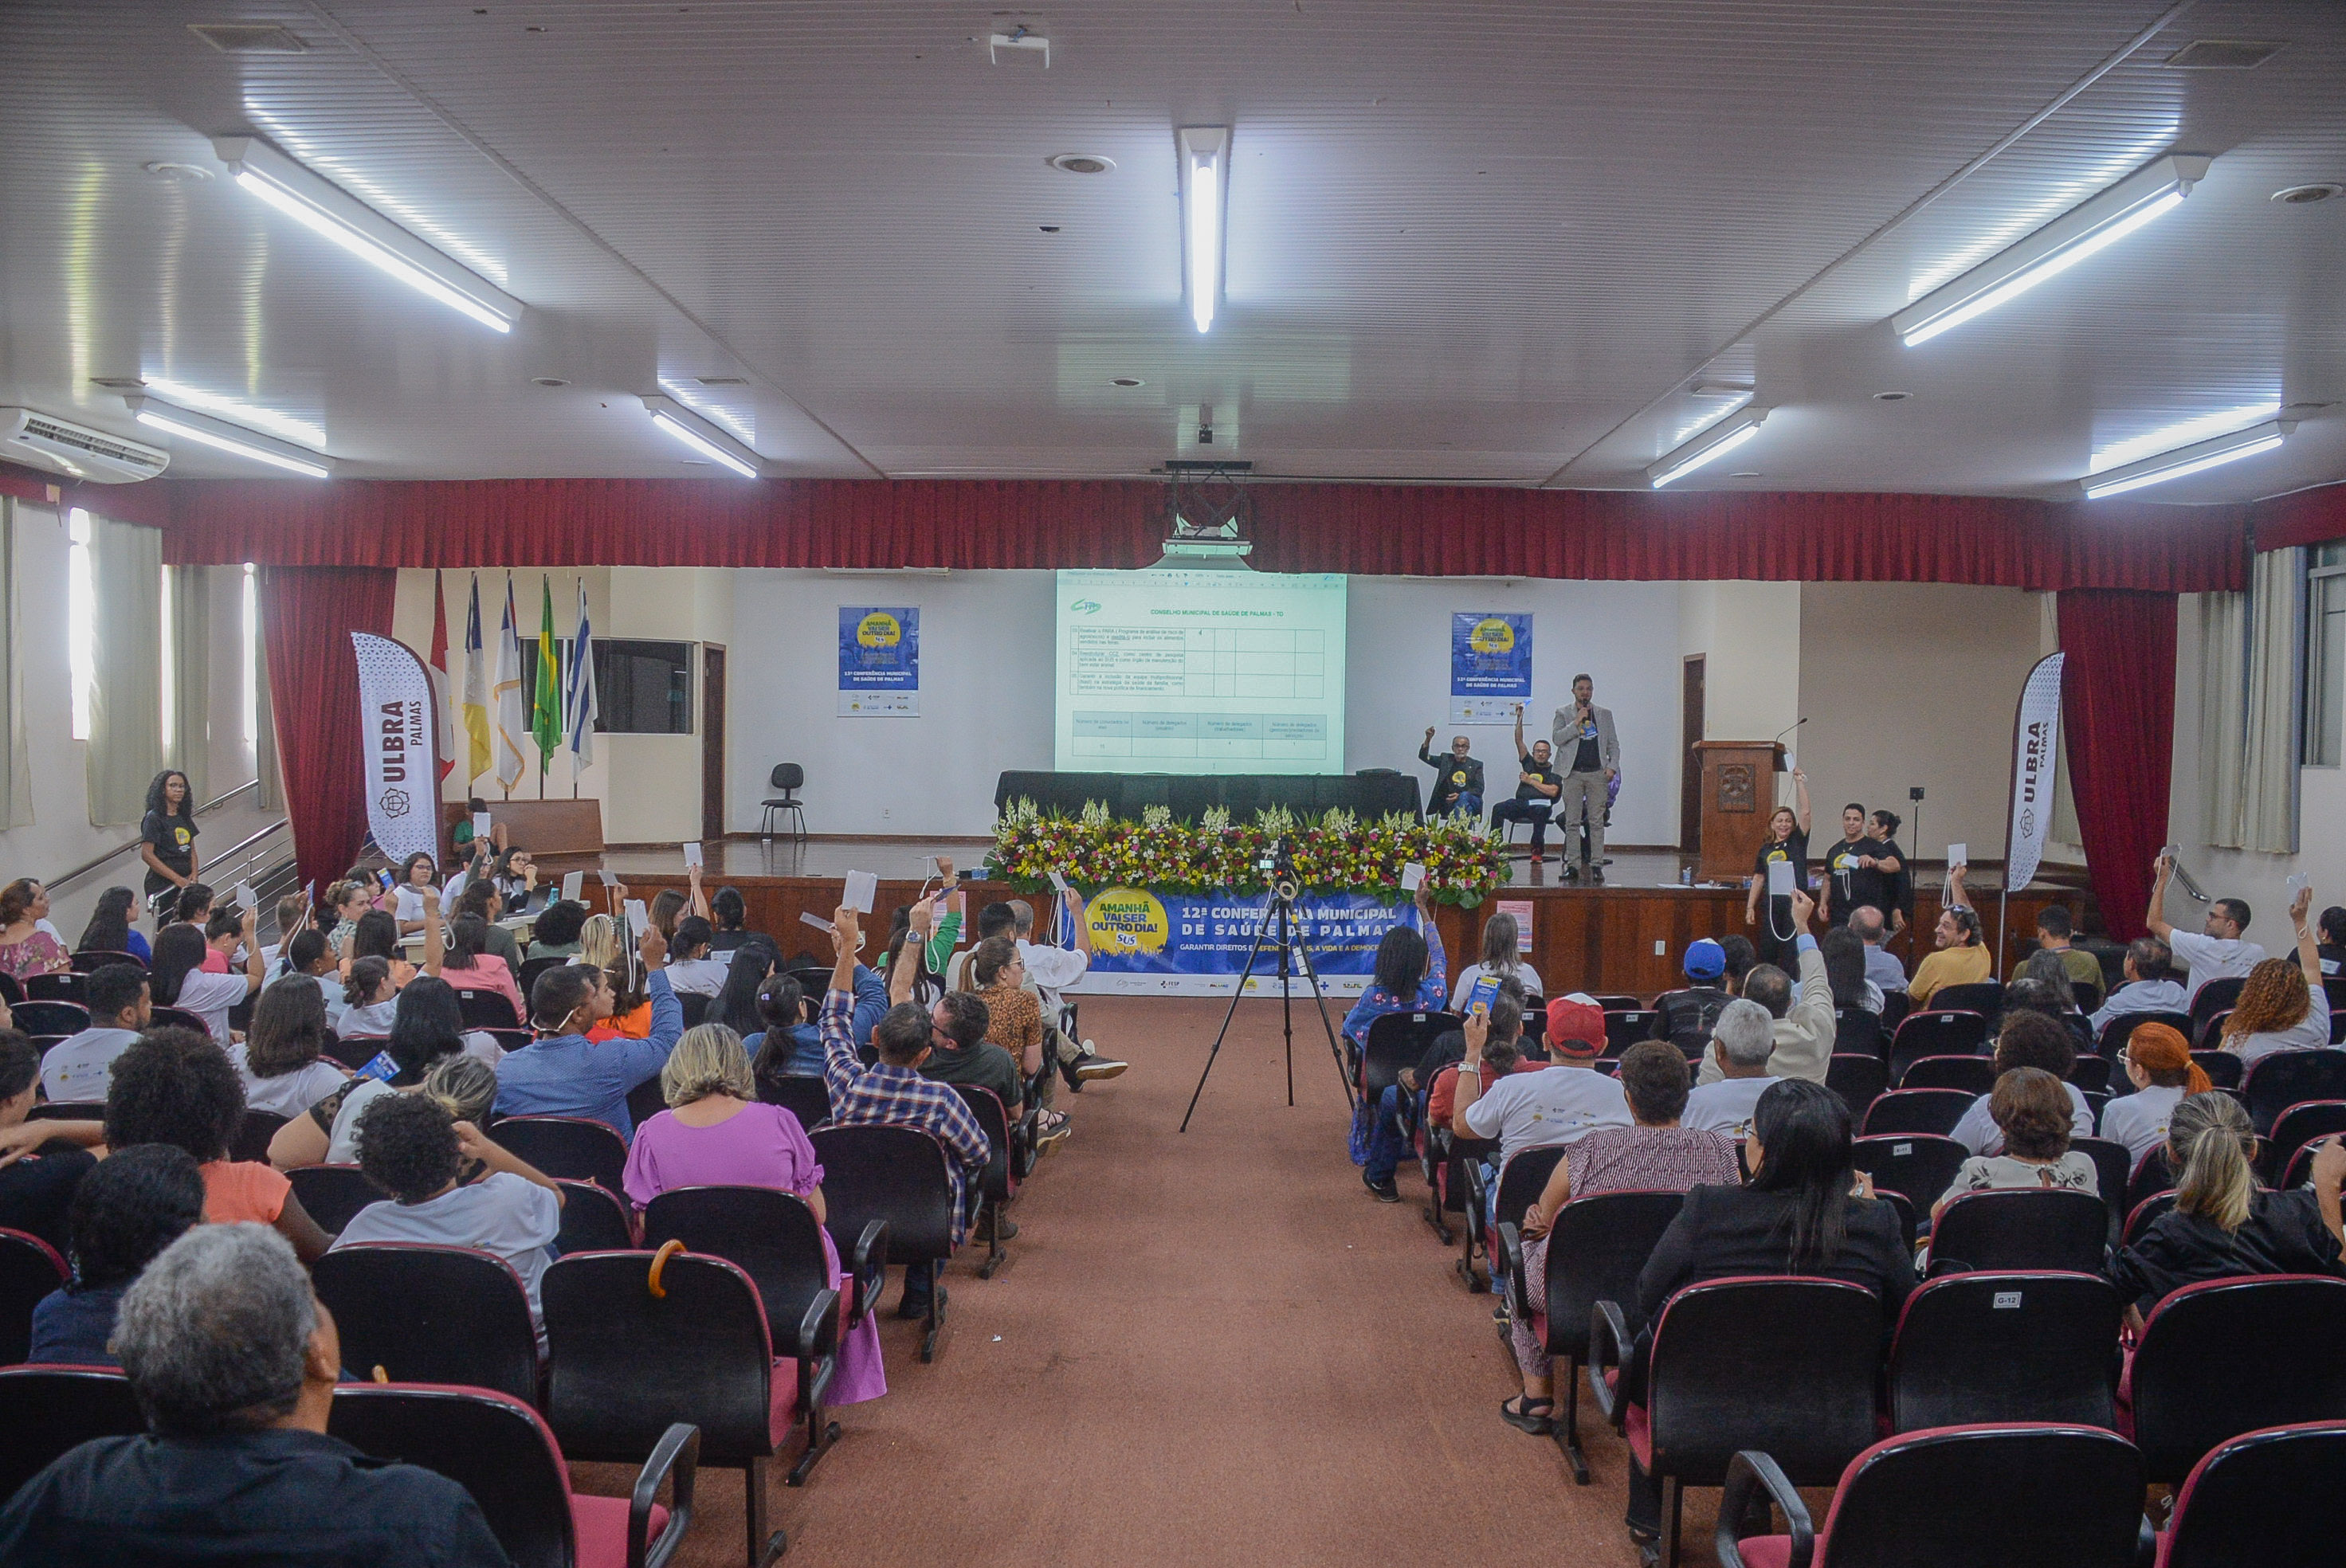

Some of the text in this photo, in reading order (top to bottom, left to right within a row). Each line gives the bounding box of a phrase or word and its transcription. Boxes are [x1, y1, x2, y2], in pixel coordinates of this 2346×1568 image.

[409, 700, 423, 747] PALMAS
[381, 700, 406, 782] ULBRA
[2039, 722, 2049, 768] PALMAS
[2024, 721, 2041, 803] ULBRA
[1100, 901, 1151, 913] AMANHÃ
[1183, 907, 1397, 920] 12ª CONFERIA MUNICIPAL
[1103, 912, 1147, 923] VAI SER
[1092, 922, 1158, 932] OUTRO DIA!
[1182, 924, 1205, 935] DE
[1287, 925, 1310, 937] DE
[1117, 934, 1136, 945] SUS
